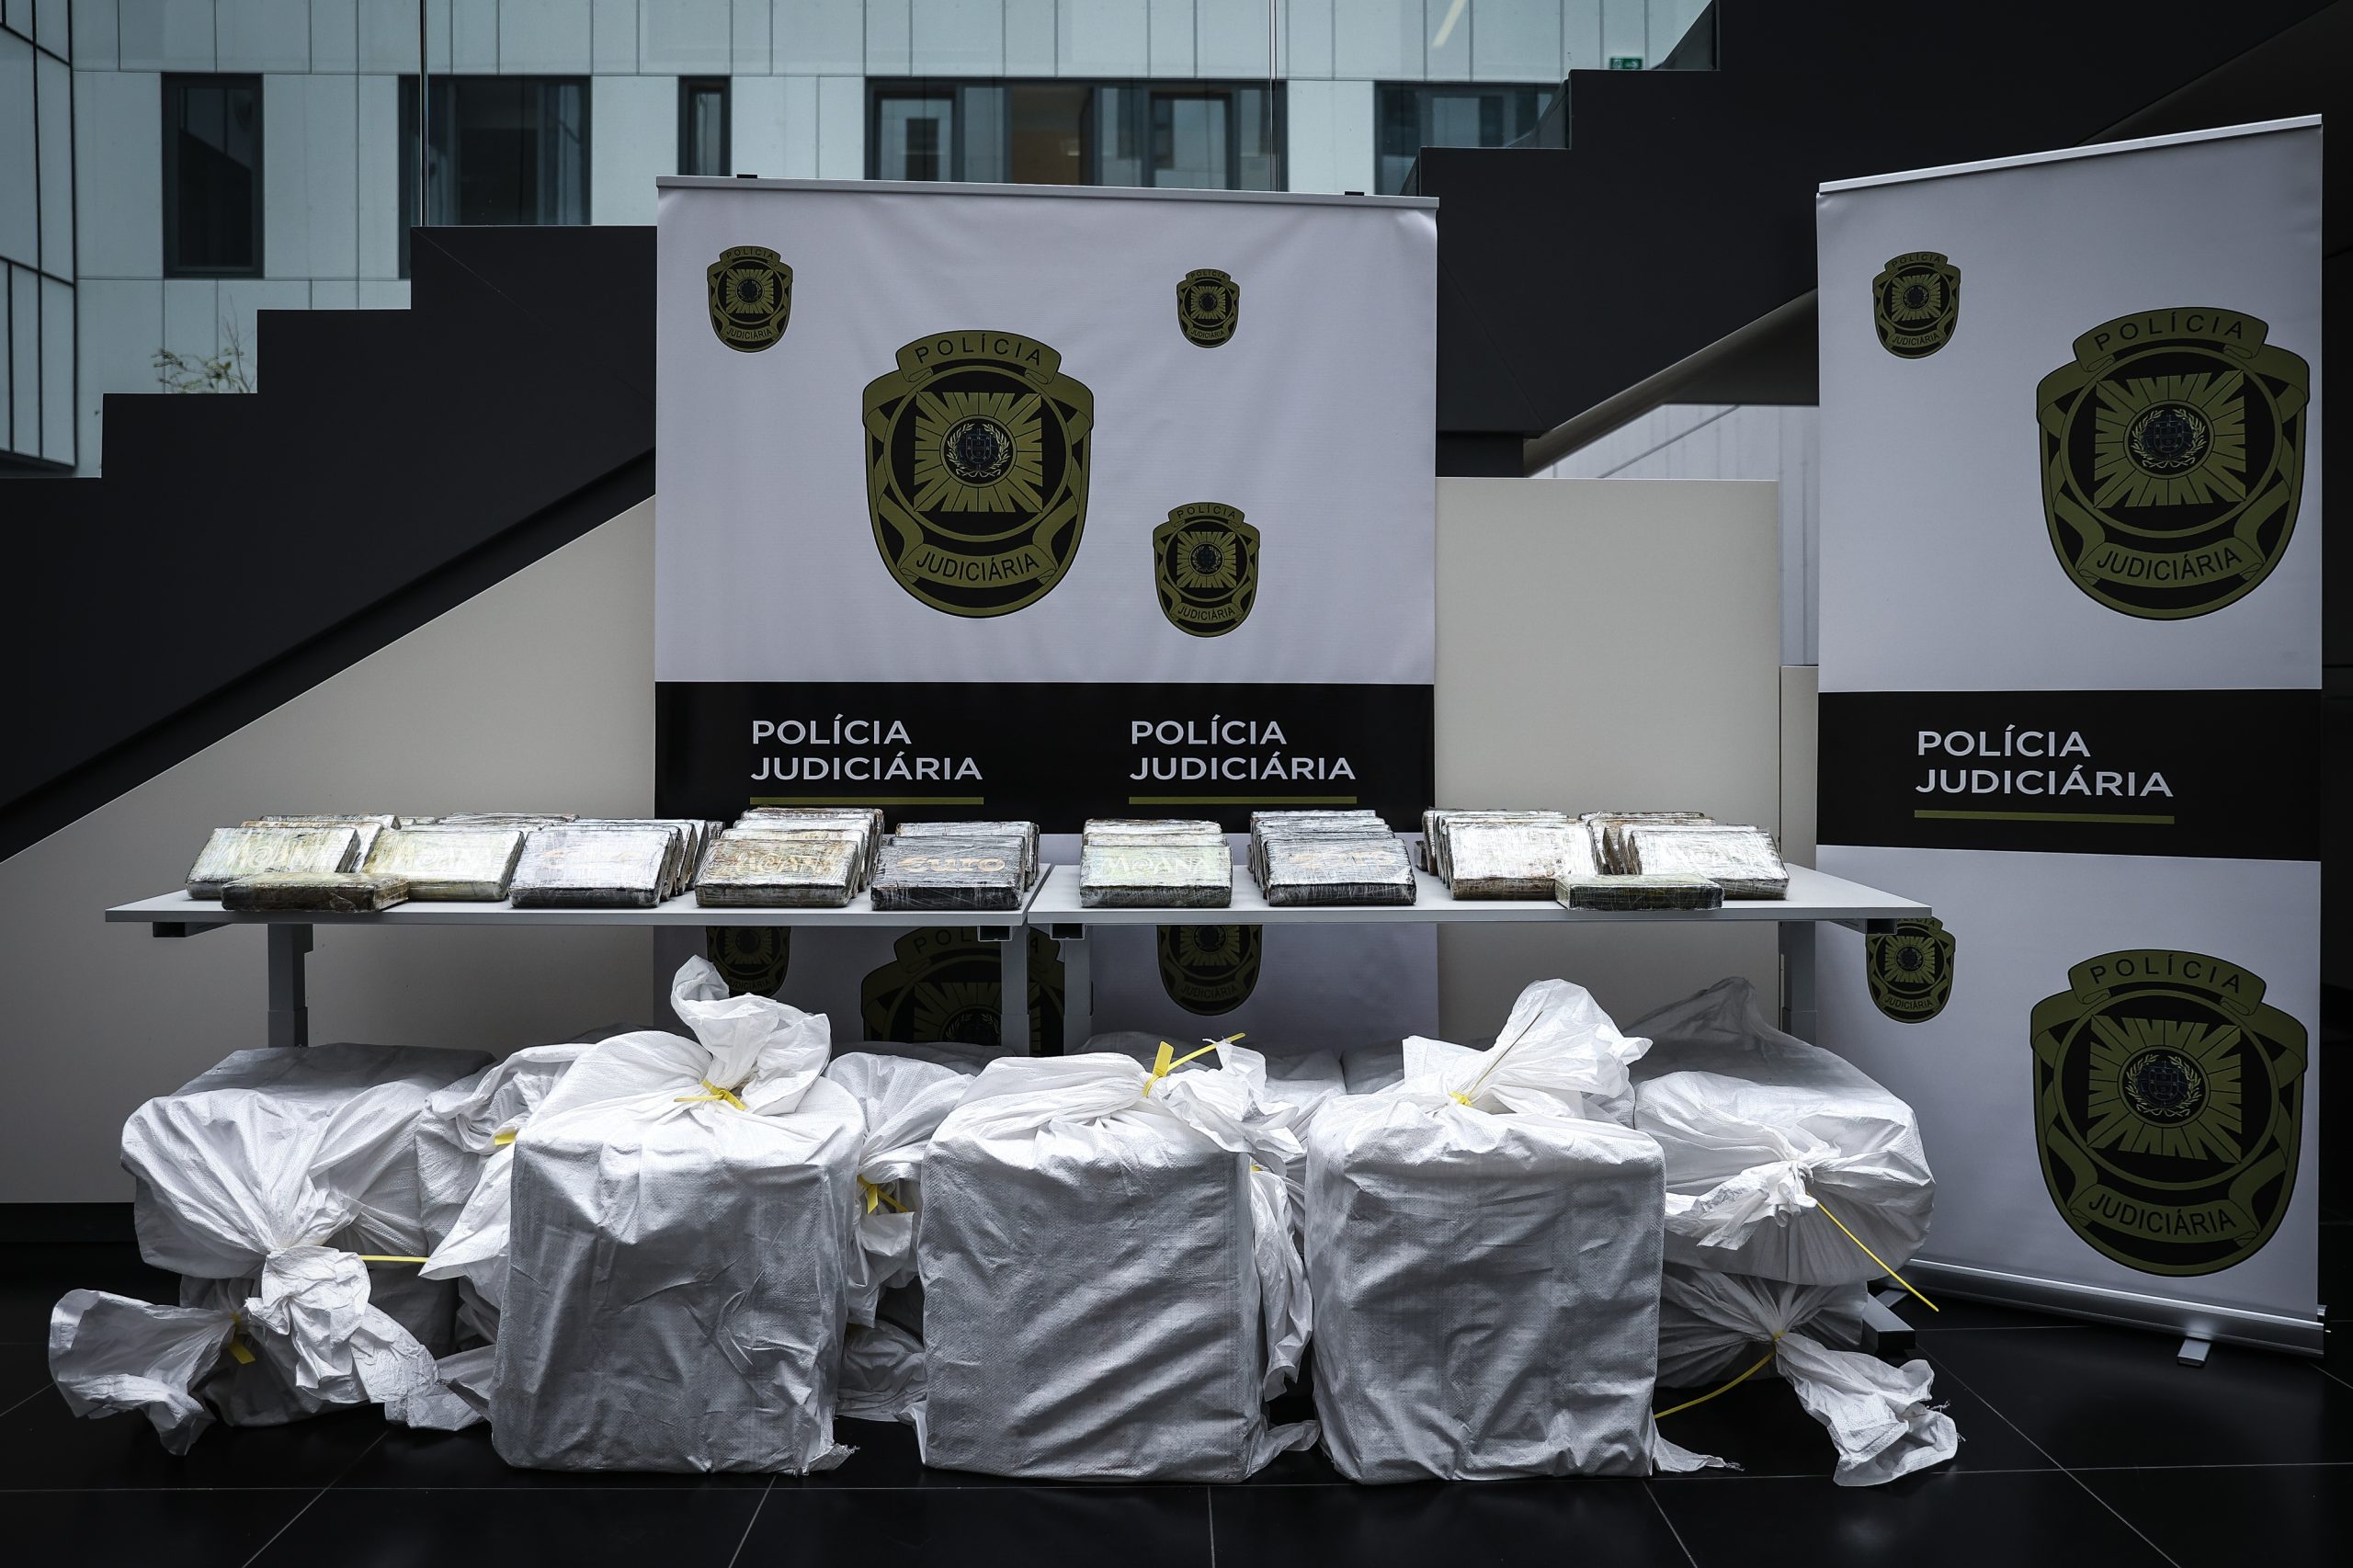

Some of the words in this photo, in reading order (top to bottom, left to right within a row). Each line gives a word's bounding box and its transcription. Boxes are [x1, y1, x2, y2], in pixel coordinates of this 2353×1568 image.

[2094, 312, 2244, 351] POLÍCIA
[915, 334, 1041, 365] POLÍCIA
[1176, 505, 1236, 518] POLÍCIA
[916, 551, 1040, 581] JUDICIÁRIA
[2097, 547, 2242, 581] JUDICIÁRIA
[1178, 607, 1235, 620] JUDICIÁRIA
[753, 714, 912, 744] POLÍCIA
[1131, 714, 1287, 744] POLÍCIA
[1918, 724, 2091, 757] POLÍCIA
[750, 751, 983, 780] JUDICIÁRIA
[1130, 751, 1356, 780] JUDICIÁRIA
[1915, 765, 2174, 797] JUDICIÁRIA
[2089, 954, 2242, 993] POLÍCIA
[2089, 1193, 2236, 1235] JUDICIÁRIA
